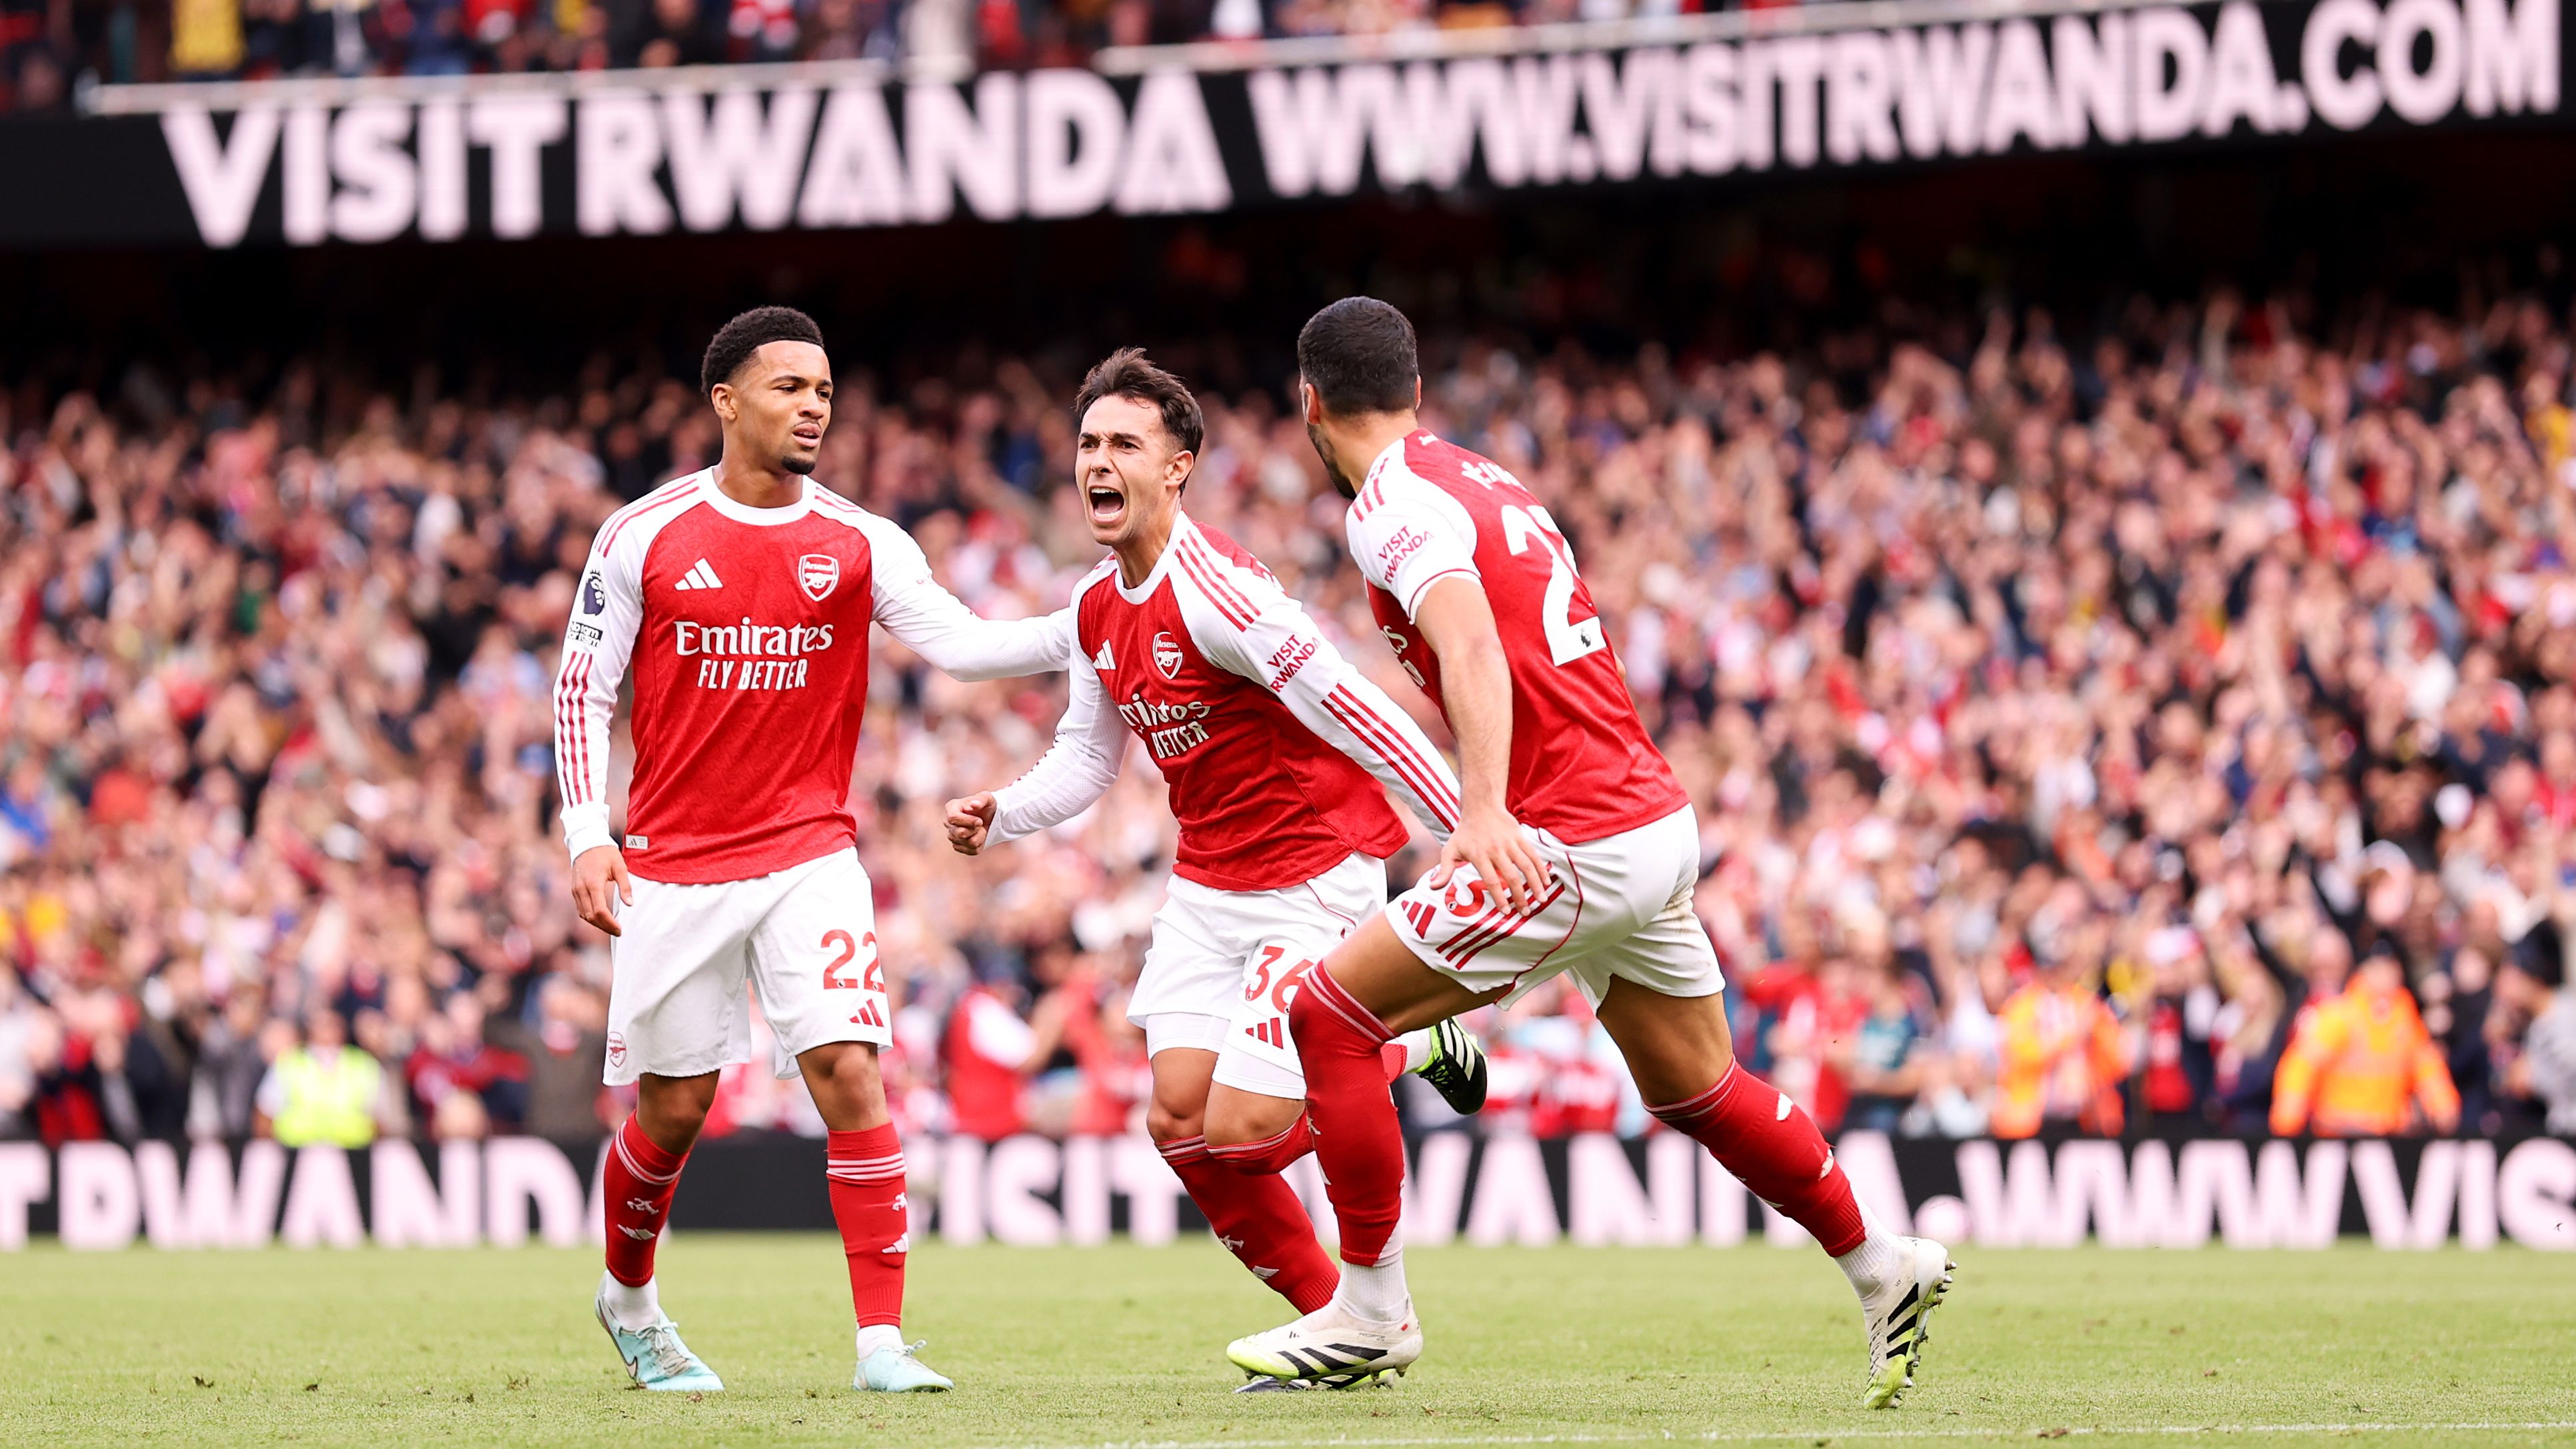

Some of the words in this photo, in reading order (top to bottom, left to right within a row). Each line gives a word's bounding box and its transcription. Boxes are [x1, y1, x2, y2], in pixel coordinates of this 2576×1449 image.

[160, 92, 569, 249] VISIT
[575, 68, 1233, 236] RWANDA
[1378, 525, 1417, 560] VISIT
[673, 617, 834, 656] Emirates
[1268, 634, 1304, 667] VISIT
[697, 659, 734, 690] FLY
[737, 659, 808, 691] BETTER
[1270, 636, 1322, 693] RWANDA
[1151, 721, 1210, 759] BETTER
[820, 929, 885, 993] 22
[57, 1138, 672, 1250] RWAND
[904, 1134, 1194, 1250] ISIT
